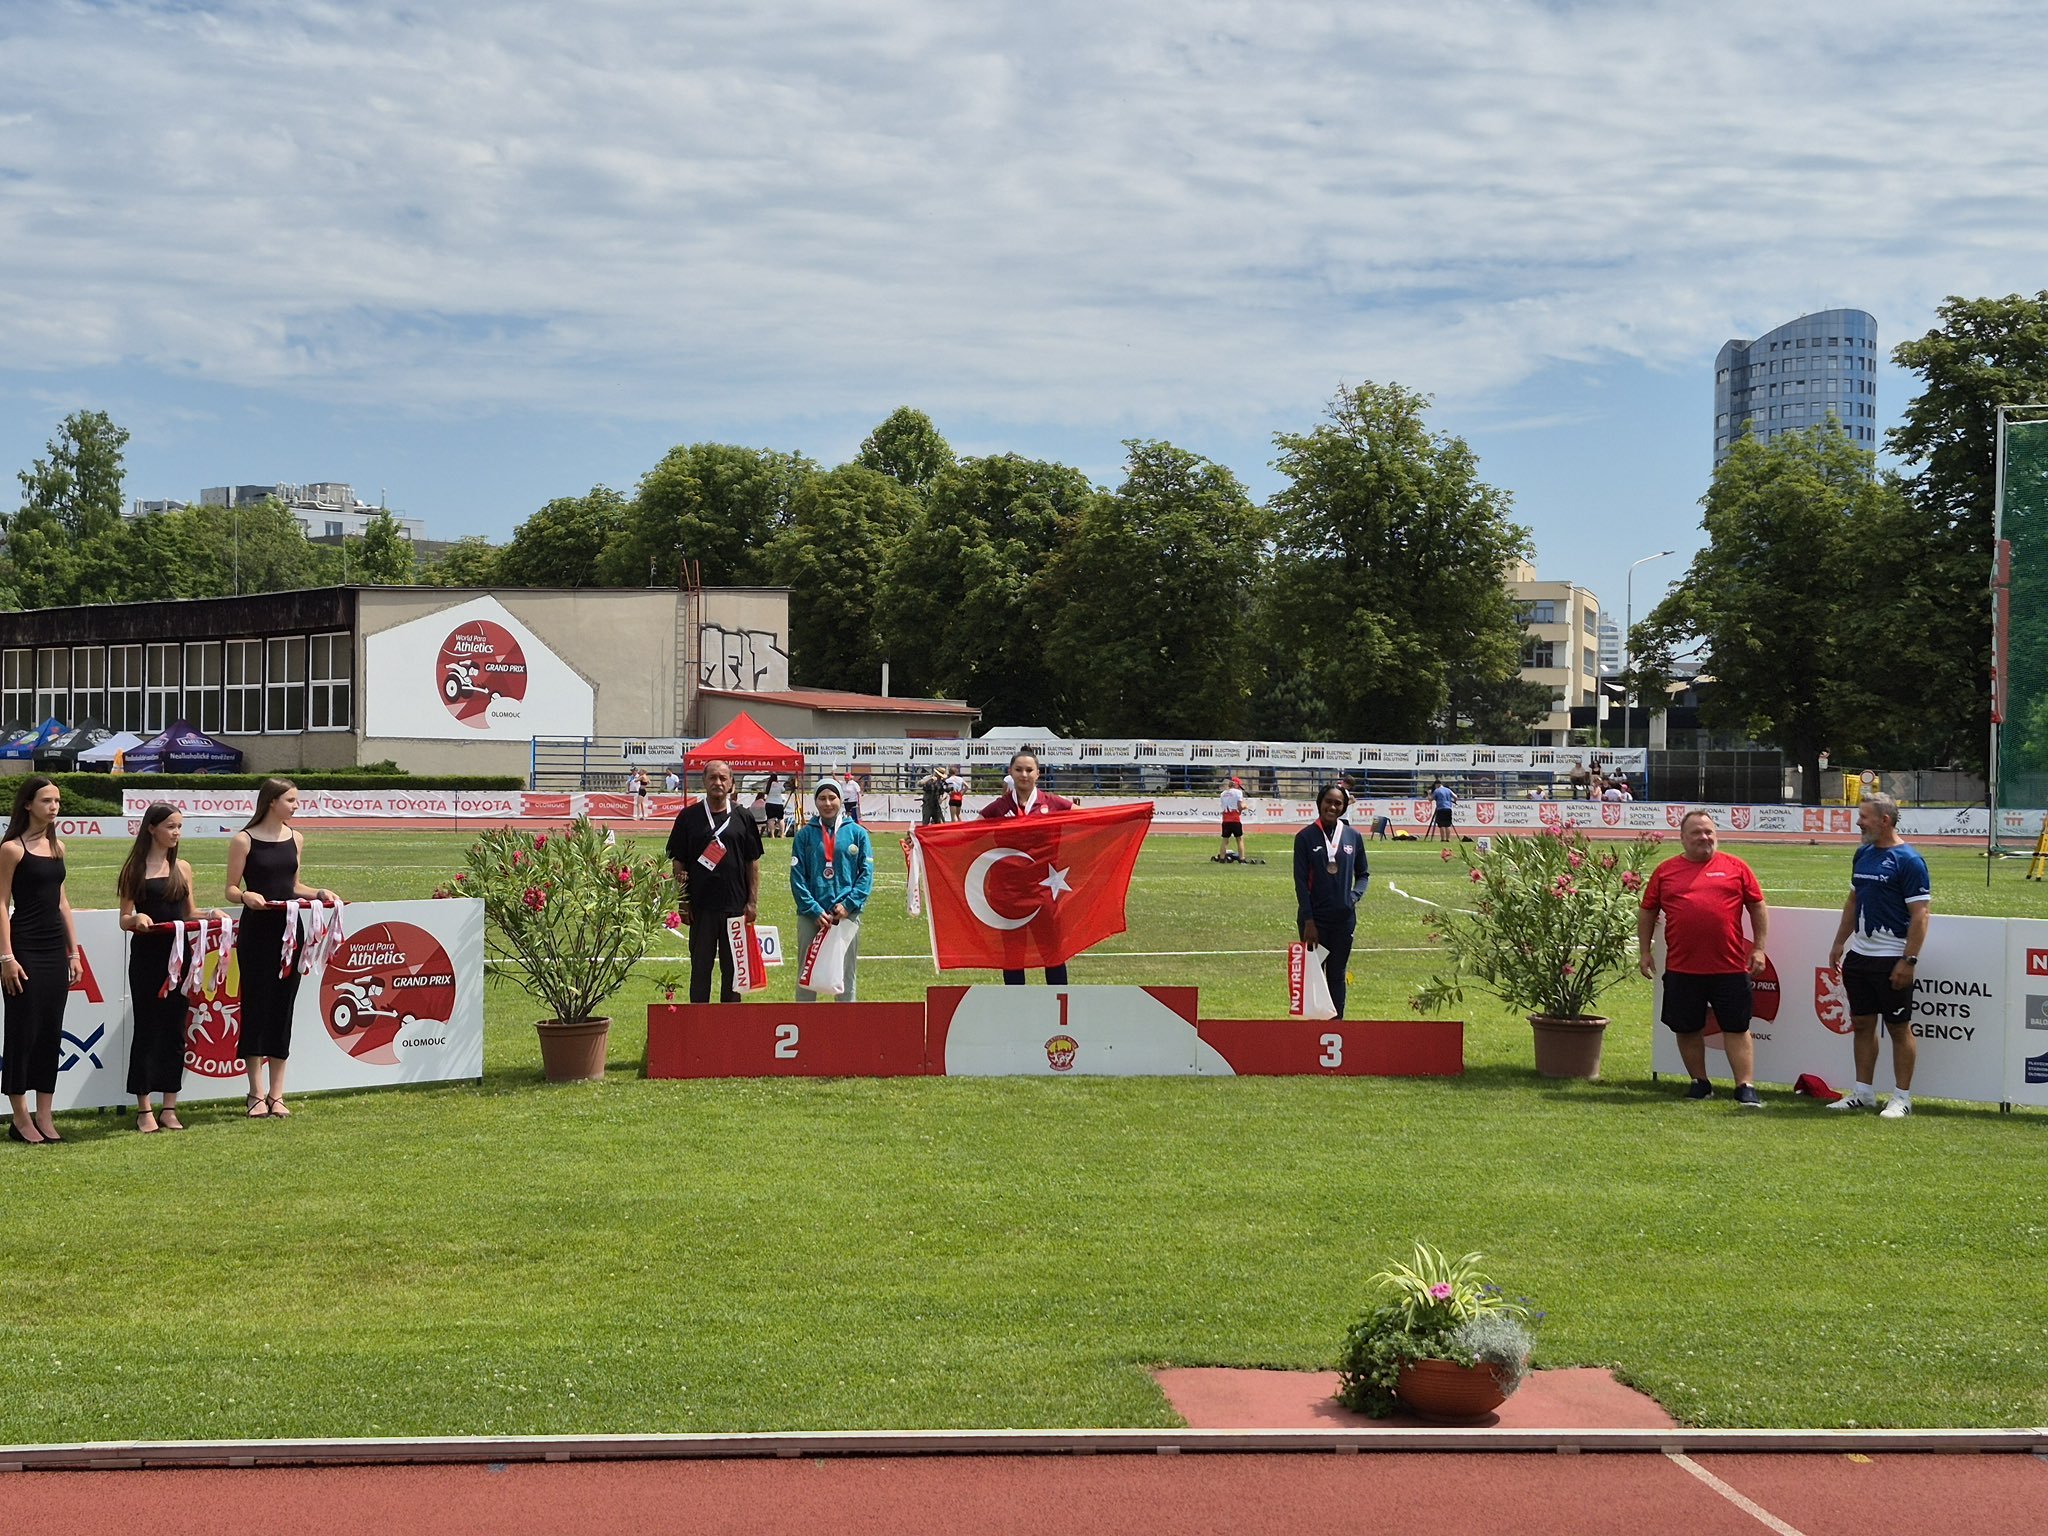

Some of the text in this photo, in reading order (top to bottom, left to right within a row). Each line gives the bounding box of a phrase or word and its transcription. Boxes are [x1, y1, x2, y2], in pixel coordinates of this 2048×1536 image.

[456, 634, 472, 642] World
[454, 642, 494, 654] Athletics
[485, 663, 509, 672] GRAND
[623, 742, 646, 758] jimi
[796, 742, 818, 758] jimi
[852, 743, 876, 759] jimi
[910, 743, 933, 760] jimi
[966, 743, 989, 760] jimi
[1079, 744, 1102, 760] jimi
[1134, 744, 1156, 760] jimi
[1190, 745, 1213, 761] jimi
[1246, 746, 1270, 762] jimi
[1301, 747, 1324, 763] jimi
[1358, 748, 1381, 764] jimi
[1415, 750, 1439, 765] jimi
[1472, 750, 1496, 766] jimi
[1530, 751, 1554, 767] jimi
[193, 800, 254, 811] TOYOTA
[324, 798, 382, 810] TOYOTA
[388, 799, 447, 810] TOYOTA
[452, 800, 512, 811] TOYOTA
[350, 942, 395, 952] World Para
[731, 920, 747, 987] NUTREND
[800, 926, 826, 980] NUTREN
[347, 951, 406, 966] Athletics
[393, 975, 451, 987] GRAND PRIX
[1290, 943, 1303, 1011] NUTREND
[1756, 982, 1776, 991] PRIX
[1912, 979, 1992, 998] ATIONAL
[1056, 993, 1068, 1025] 1
[1910, 1001, 1970, 1018] PORTS
[1750, 1033, 1772, 1041] MOUC
[1912, 1023, 1975, 1041] GENCY
[402, 1037, 446, 1047] OLOMOUC
[775, 1024, 799, 1058] 2
[1320, 1033, 1343, 1067] 3
[184, 1050, 246, 1074] OLOMO
